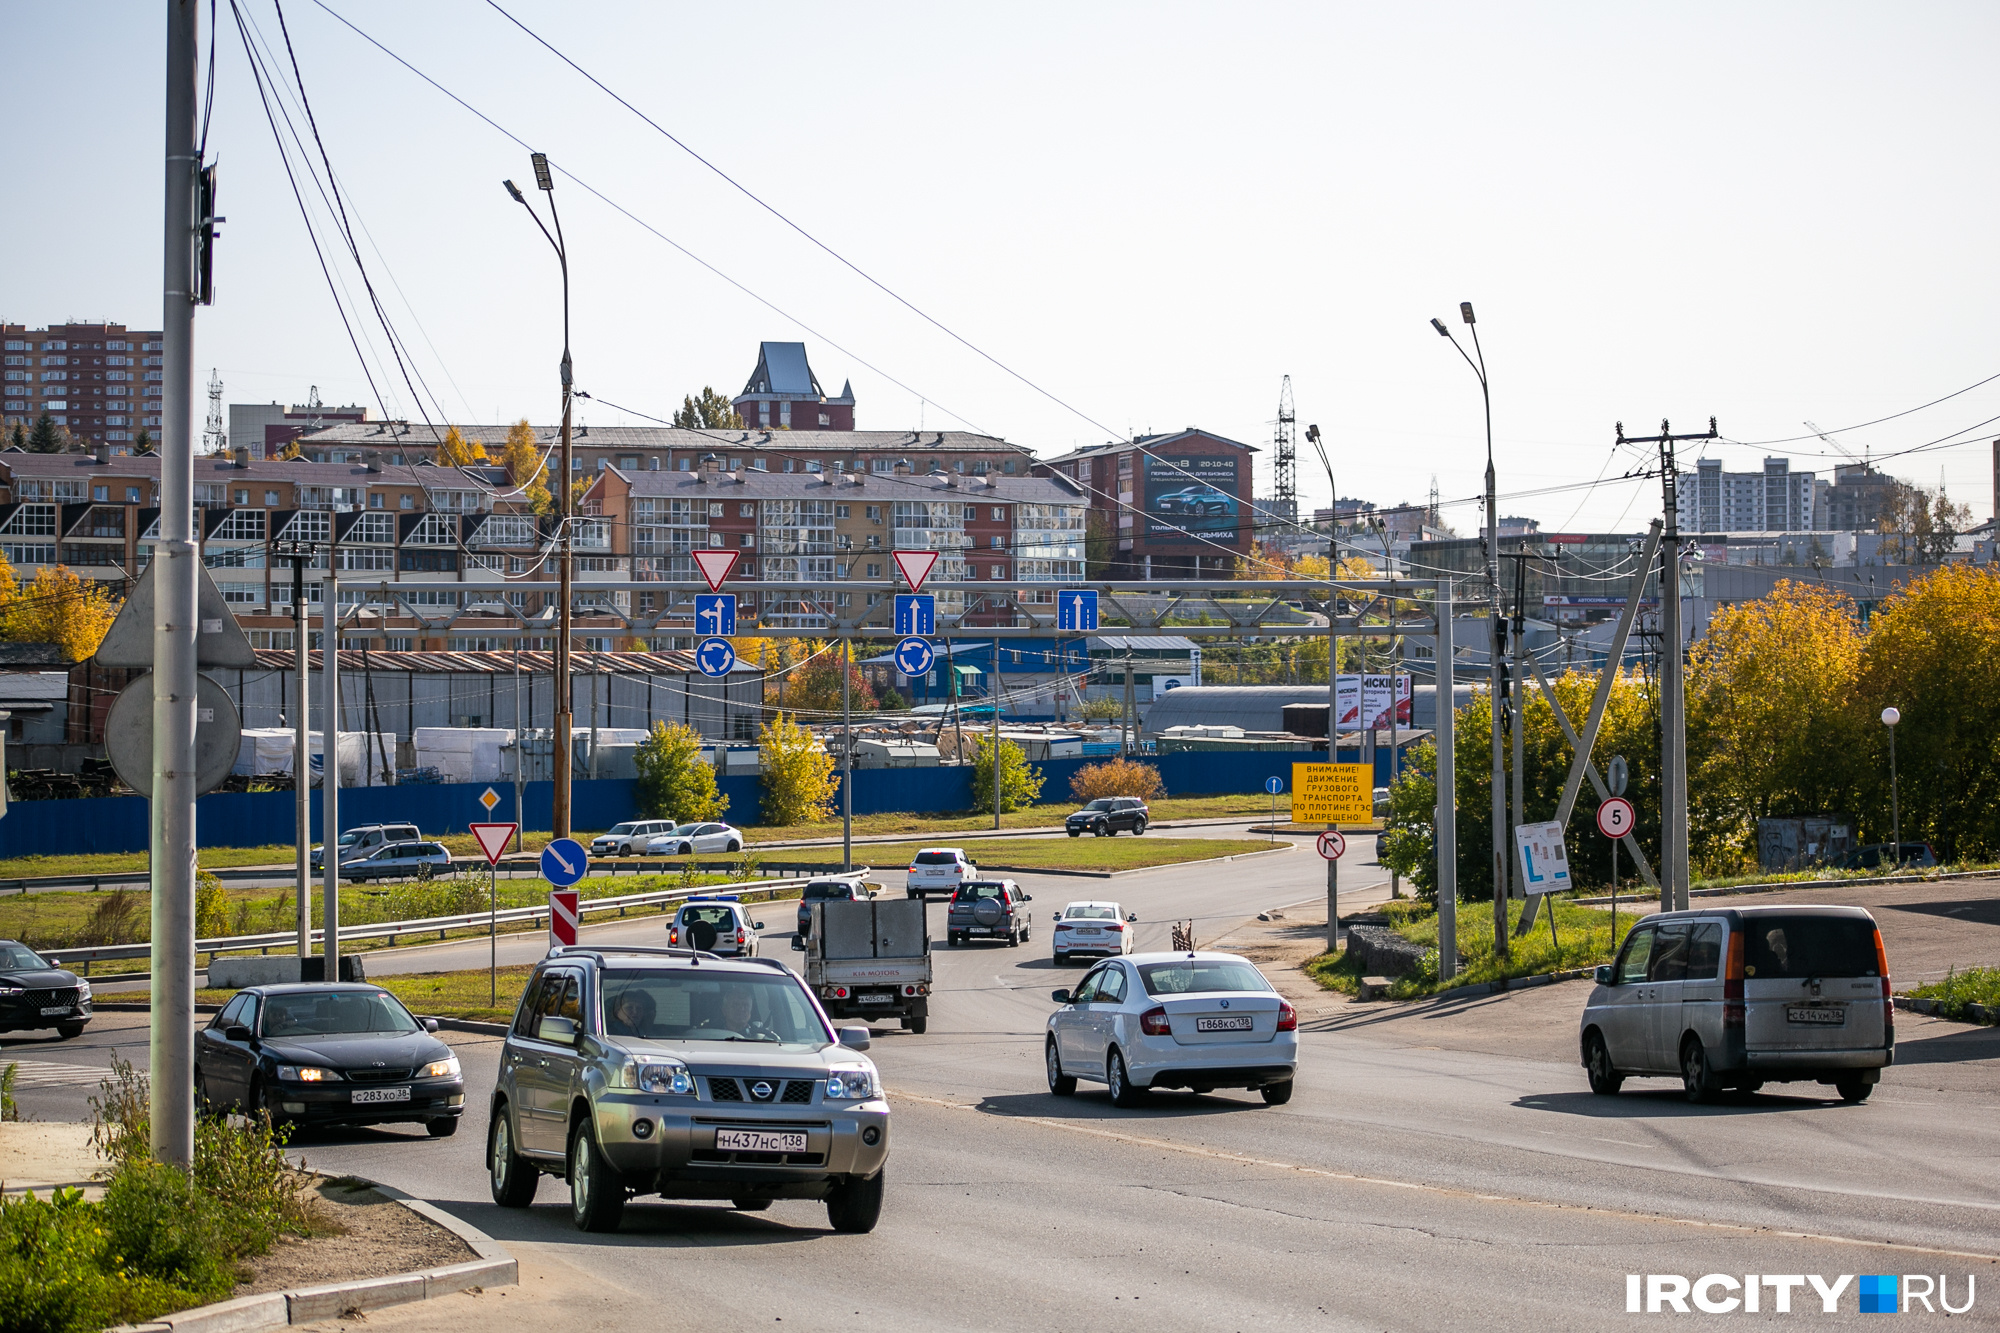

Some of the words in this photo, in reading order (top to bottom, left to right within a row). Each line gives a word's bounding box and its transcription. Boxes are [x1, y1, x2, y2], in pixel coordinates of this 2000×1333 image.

[1180, 459, 1190, 468] 8
[1306, 775, 1358, 783] ДВИЖЕНИЕ
[1293, 803, 1306, 811] ПО
[1308, 803, 1351, 811] ПЛОТИНЕ
[1354, 804, 1371, 812] ГЭС
[1303, 813, 1362, 822] ЗАПРЕЩЕНО!
[1612, 809, 1622, 825] 5
[1200, 1019, 1236, 1029] Т868КО
[1236, 1018, 1250, 1026] 138
[355, 1090, 396, 1102] С283ХО
[397, 1089, 407, 1097] 38
[722, 1132, 779, 1150] Н437НС
[781, 1134, 803, 1147] 138
